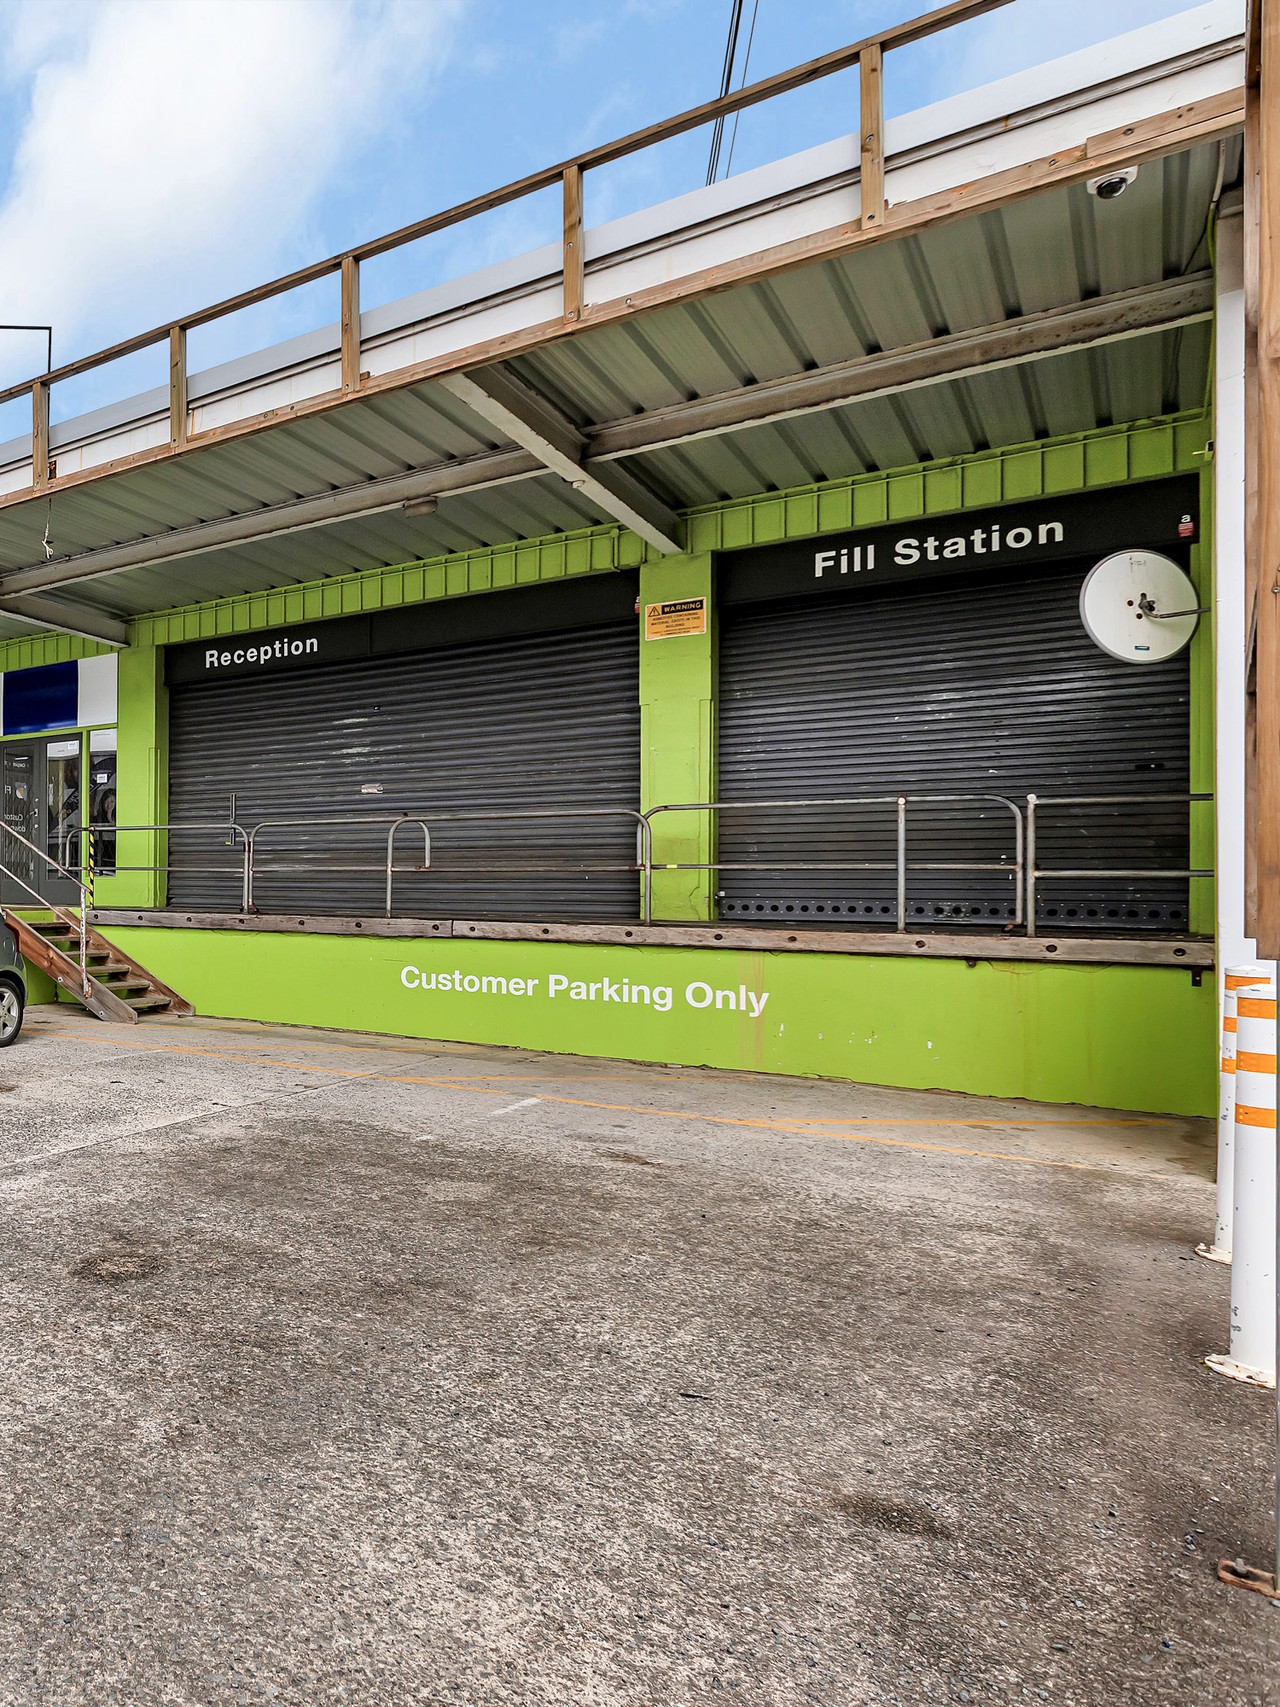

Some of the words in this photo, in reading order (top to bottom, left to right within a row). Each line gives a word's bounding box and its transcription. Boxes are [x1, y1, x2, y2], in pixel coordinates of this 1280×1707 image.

[814, 545, 875, 578] Fill
[893, 521, 1065, 565] Station
[664, 602, 701, 613] WARNING
[205, 637, 318, 669] Reception
[400, 965, 539, 997] Customer
[548, 974, 673, 1012] Parking
[685, 981, 770, 1018] Only
